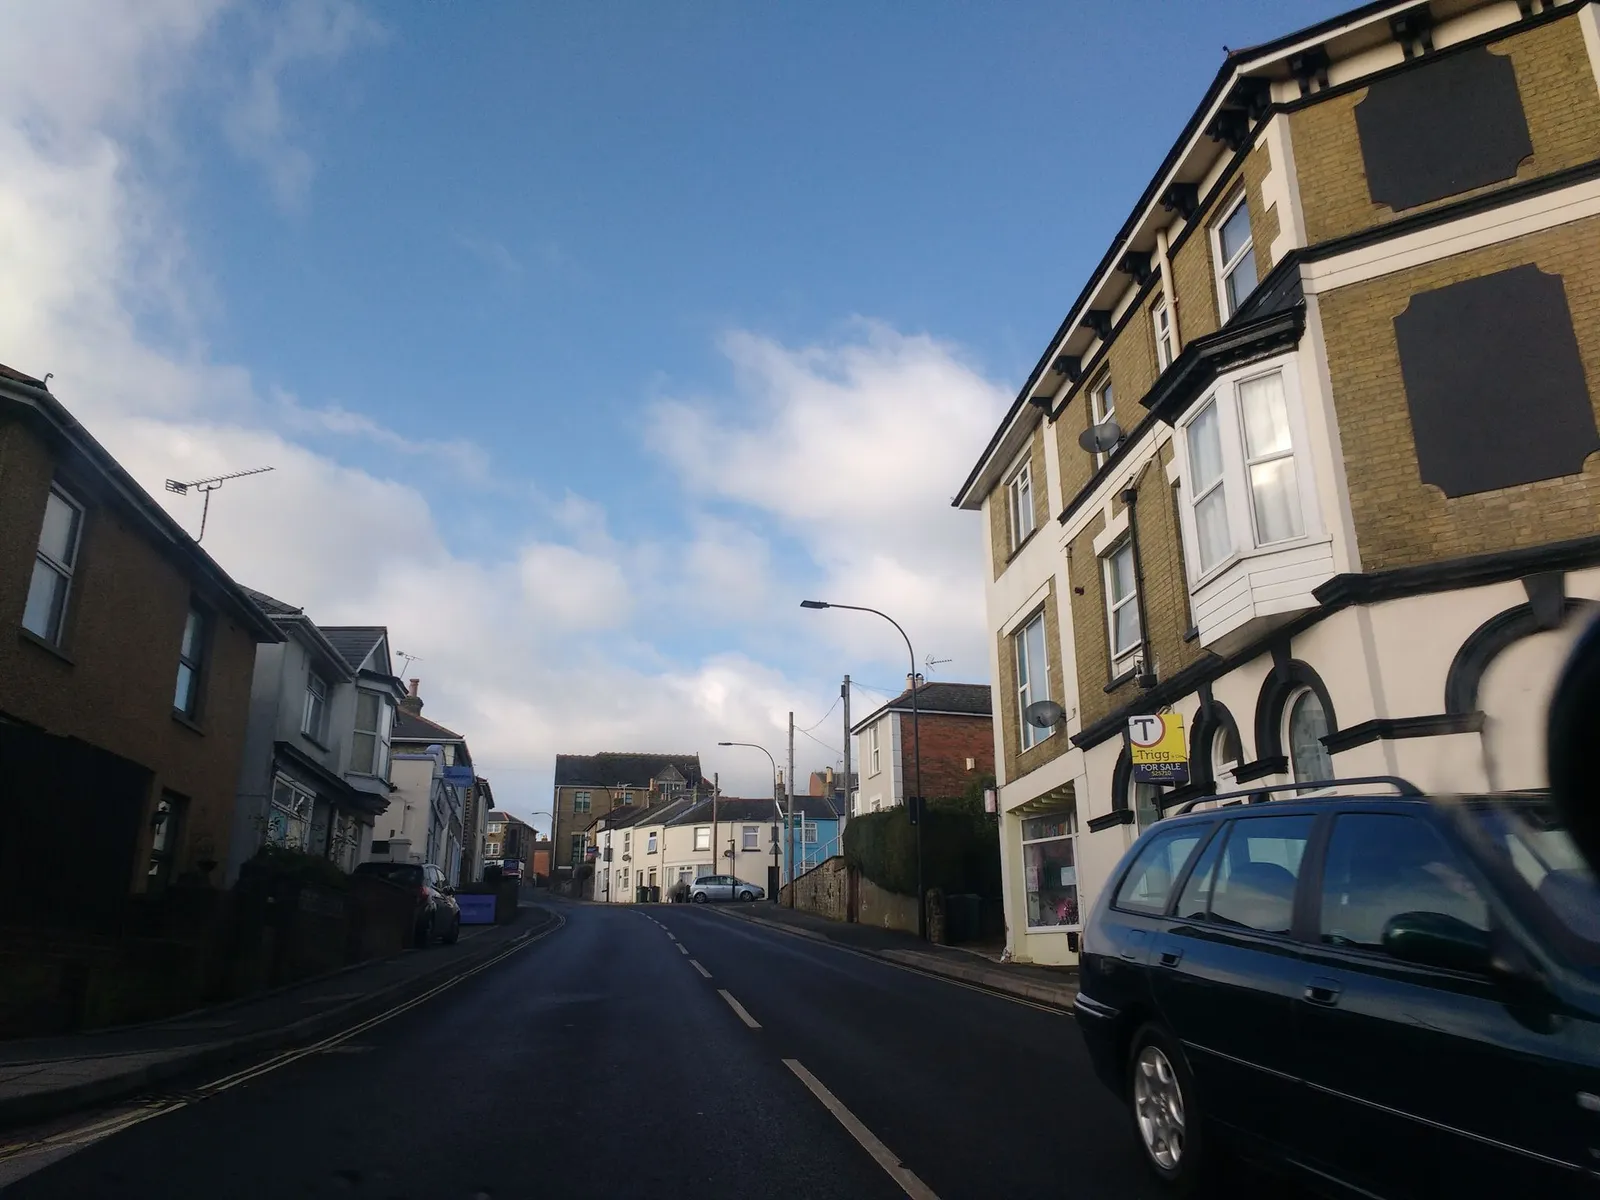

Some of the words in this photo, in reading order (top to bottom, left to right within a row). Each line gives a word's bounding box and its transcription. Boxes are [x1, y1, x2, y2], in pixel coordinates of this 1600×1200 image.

[1134, 719, 1154, 741] T
[1137, 750, 1170, 761] Trigg
[1160, 763, 1181, 771] SALE
